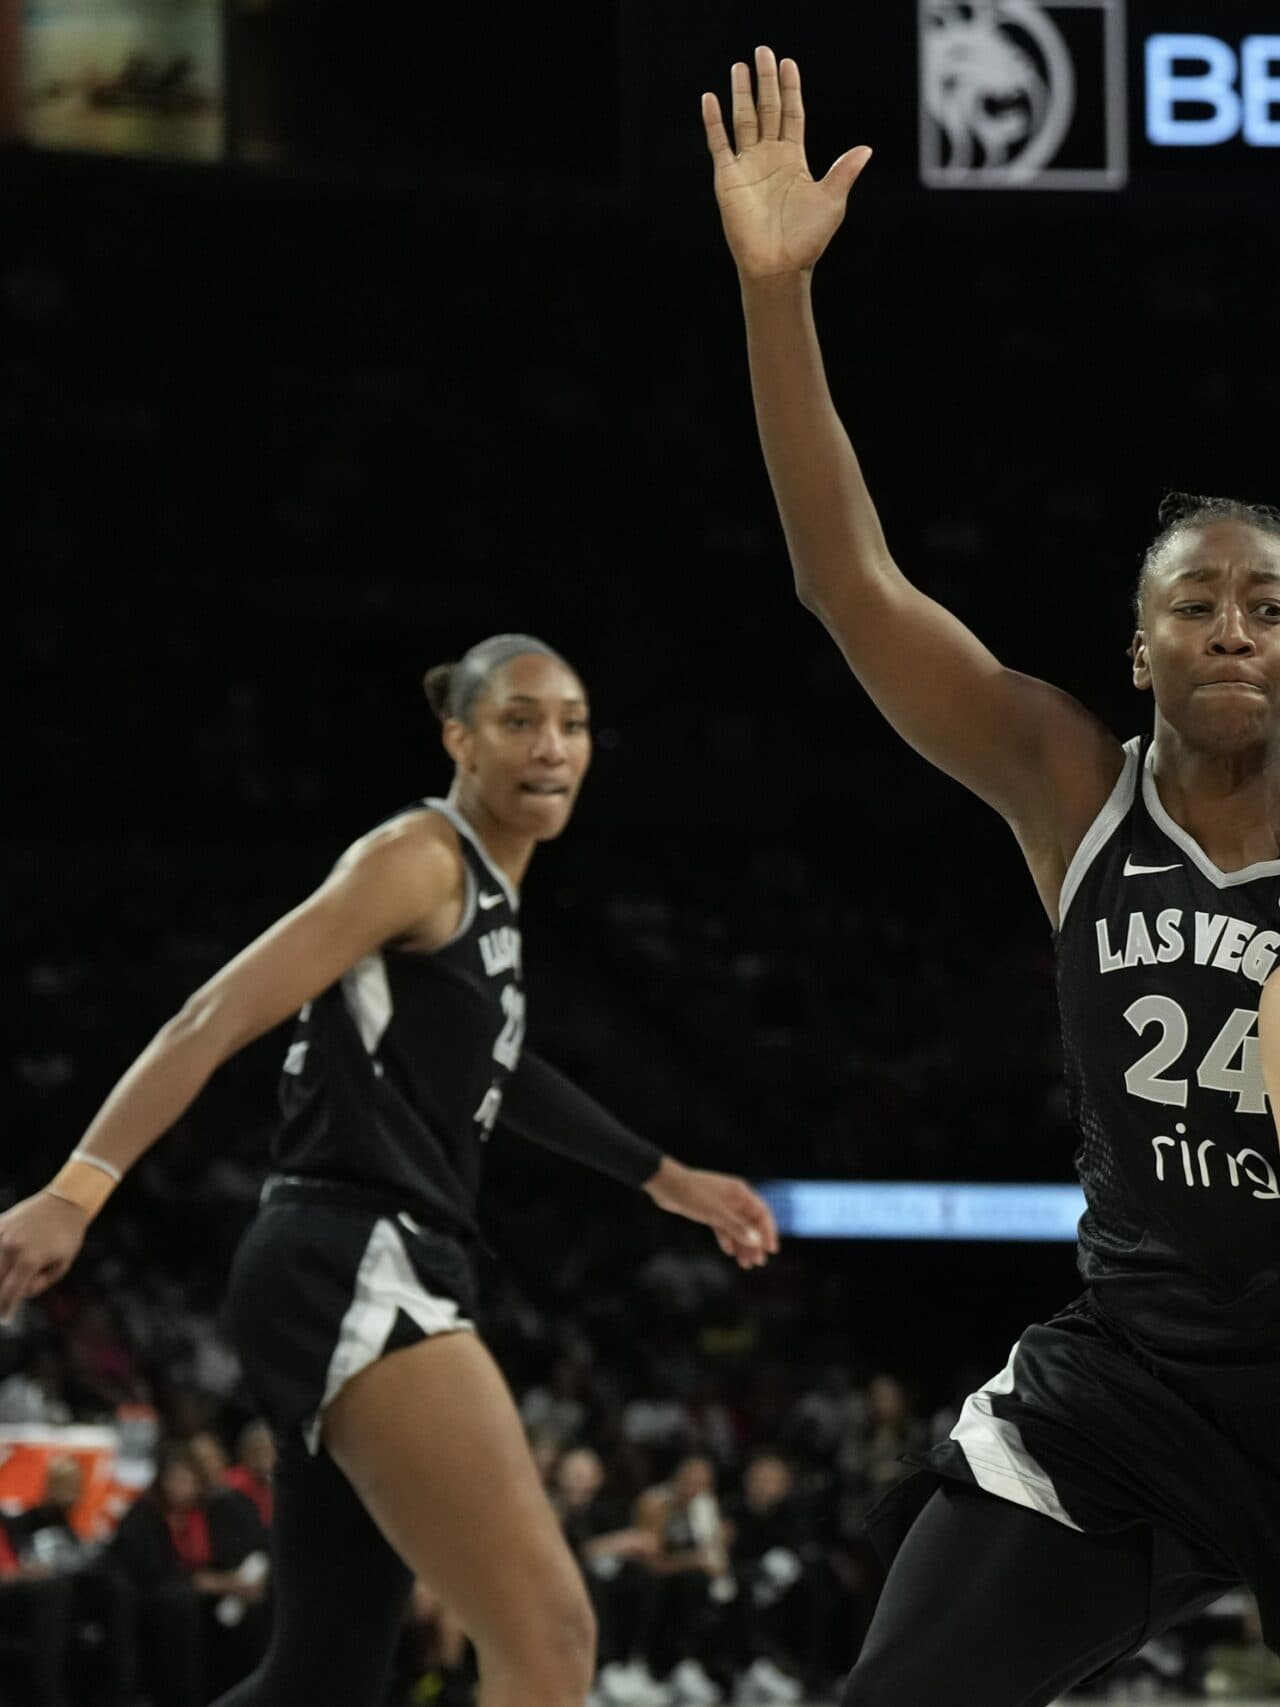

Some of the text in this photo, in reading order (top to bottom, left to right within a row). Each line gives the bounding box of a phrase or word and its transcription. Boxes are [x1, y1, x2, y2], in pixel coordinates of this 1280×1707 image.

[1095, 908, 1186, 974] LAS
[1122, 994, 1271, 1114] 24
[1151, 1122, 1280, 1200] ring
